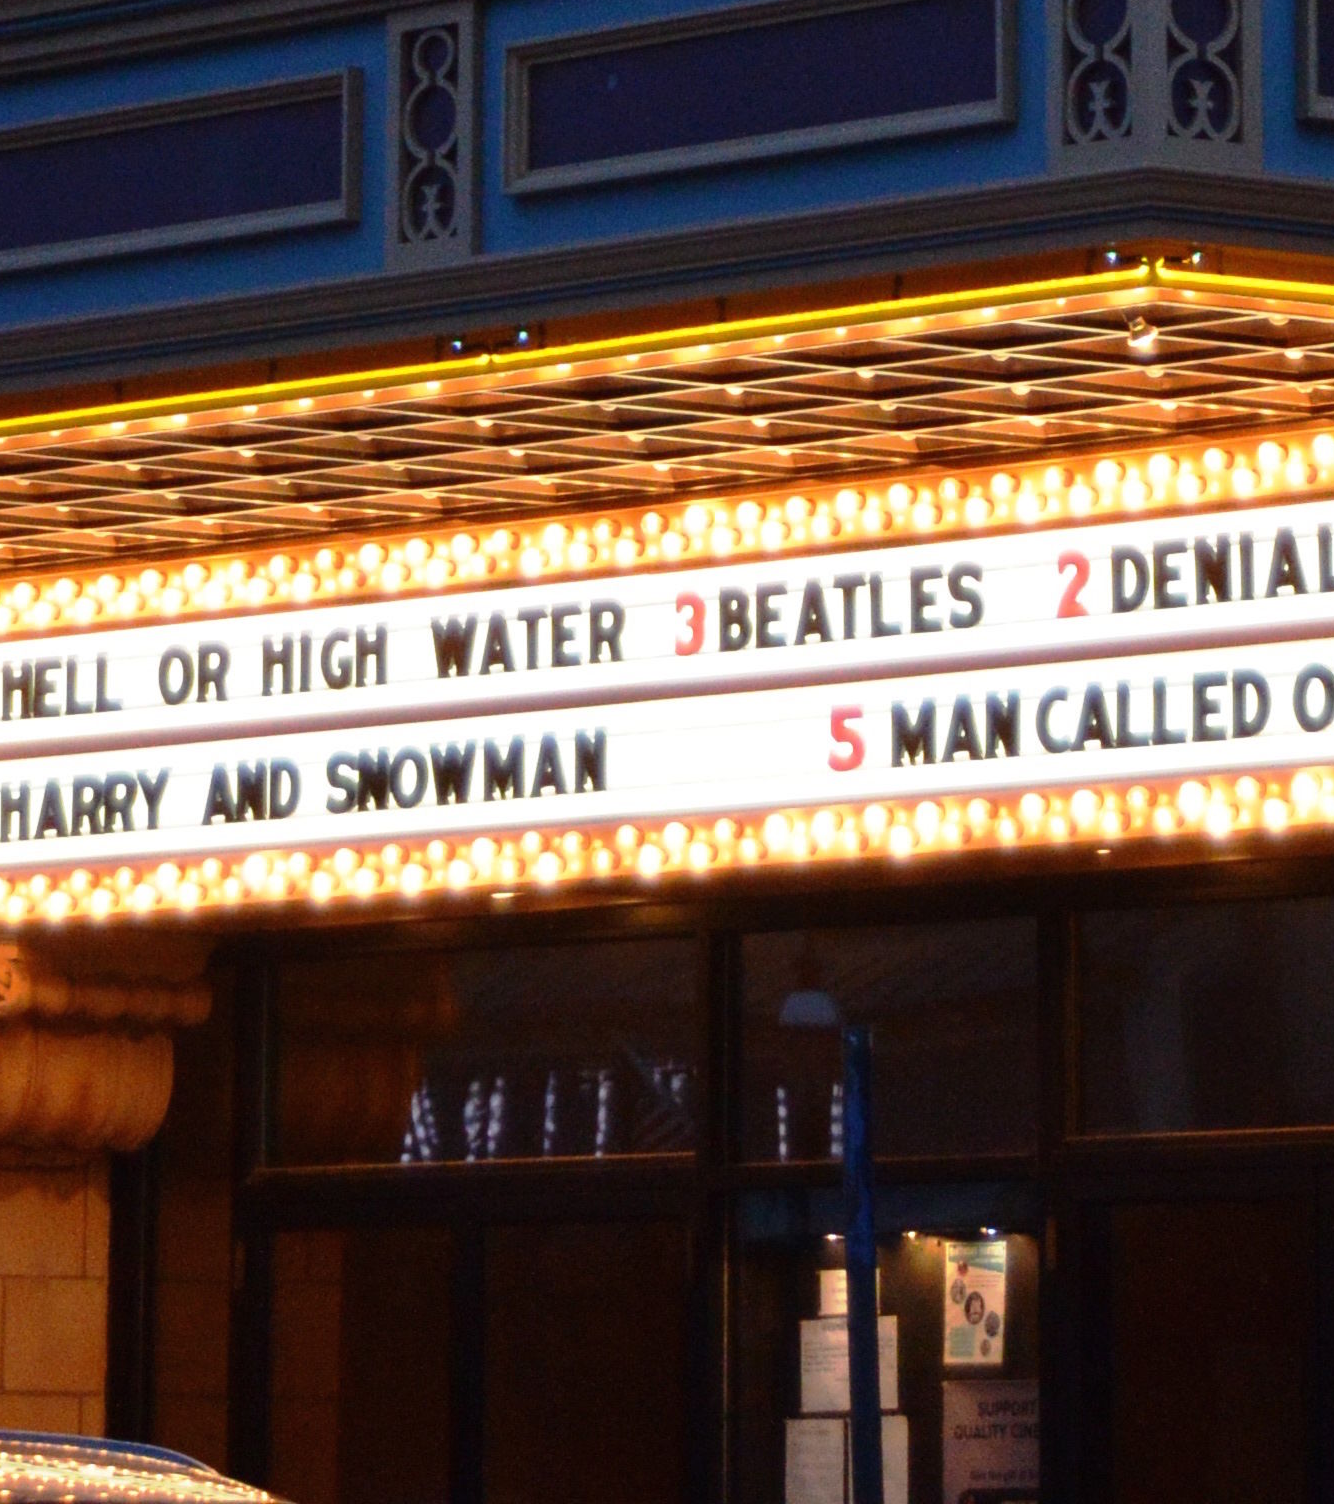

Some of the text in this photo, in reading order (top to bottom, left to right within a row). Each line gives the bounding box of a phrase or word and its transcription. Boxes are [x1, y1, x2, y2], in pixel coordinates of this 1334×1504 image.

[0, 652, 124, 721] HELL
[157, 640, 231, 706] OR
[260, 621, 389, 698] HIGH
[432, 599, 626, 680] WATER
[674, 592, 706, 657] 3
[718, 561, 985, 653] BEATLES
[1056, 550, 1091, 619] 2
[0, 766, 171, 843] HARRY
[201, 756, 301, 826] AND
[325, 727, 609, 814] SNOWMAN
[828, 705, 866, 772] 5
[890, 688, 1021, 768] MAN
[1035, 669, 1272, 754] CALLED
